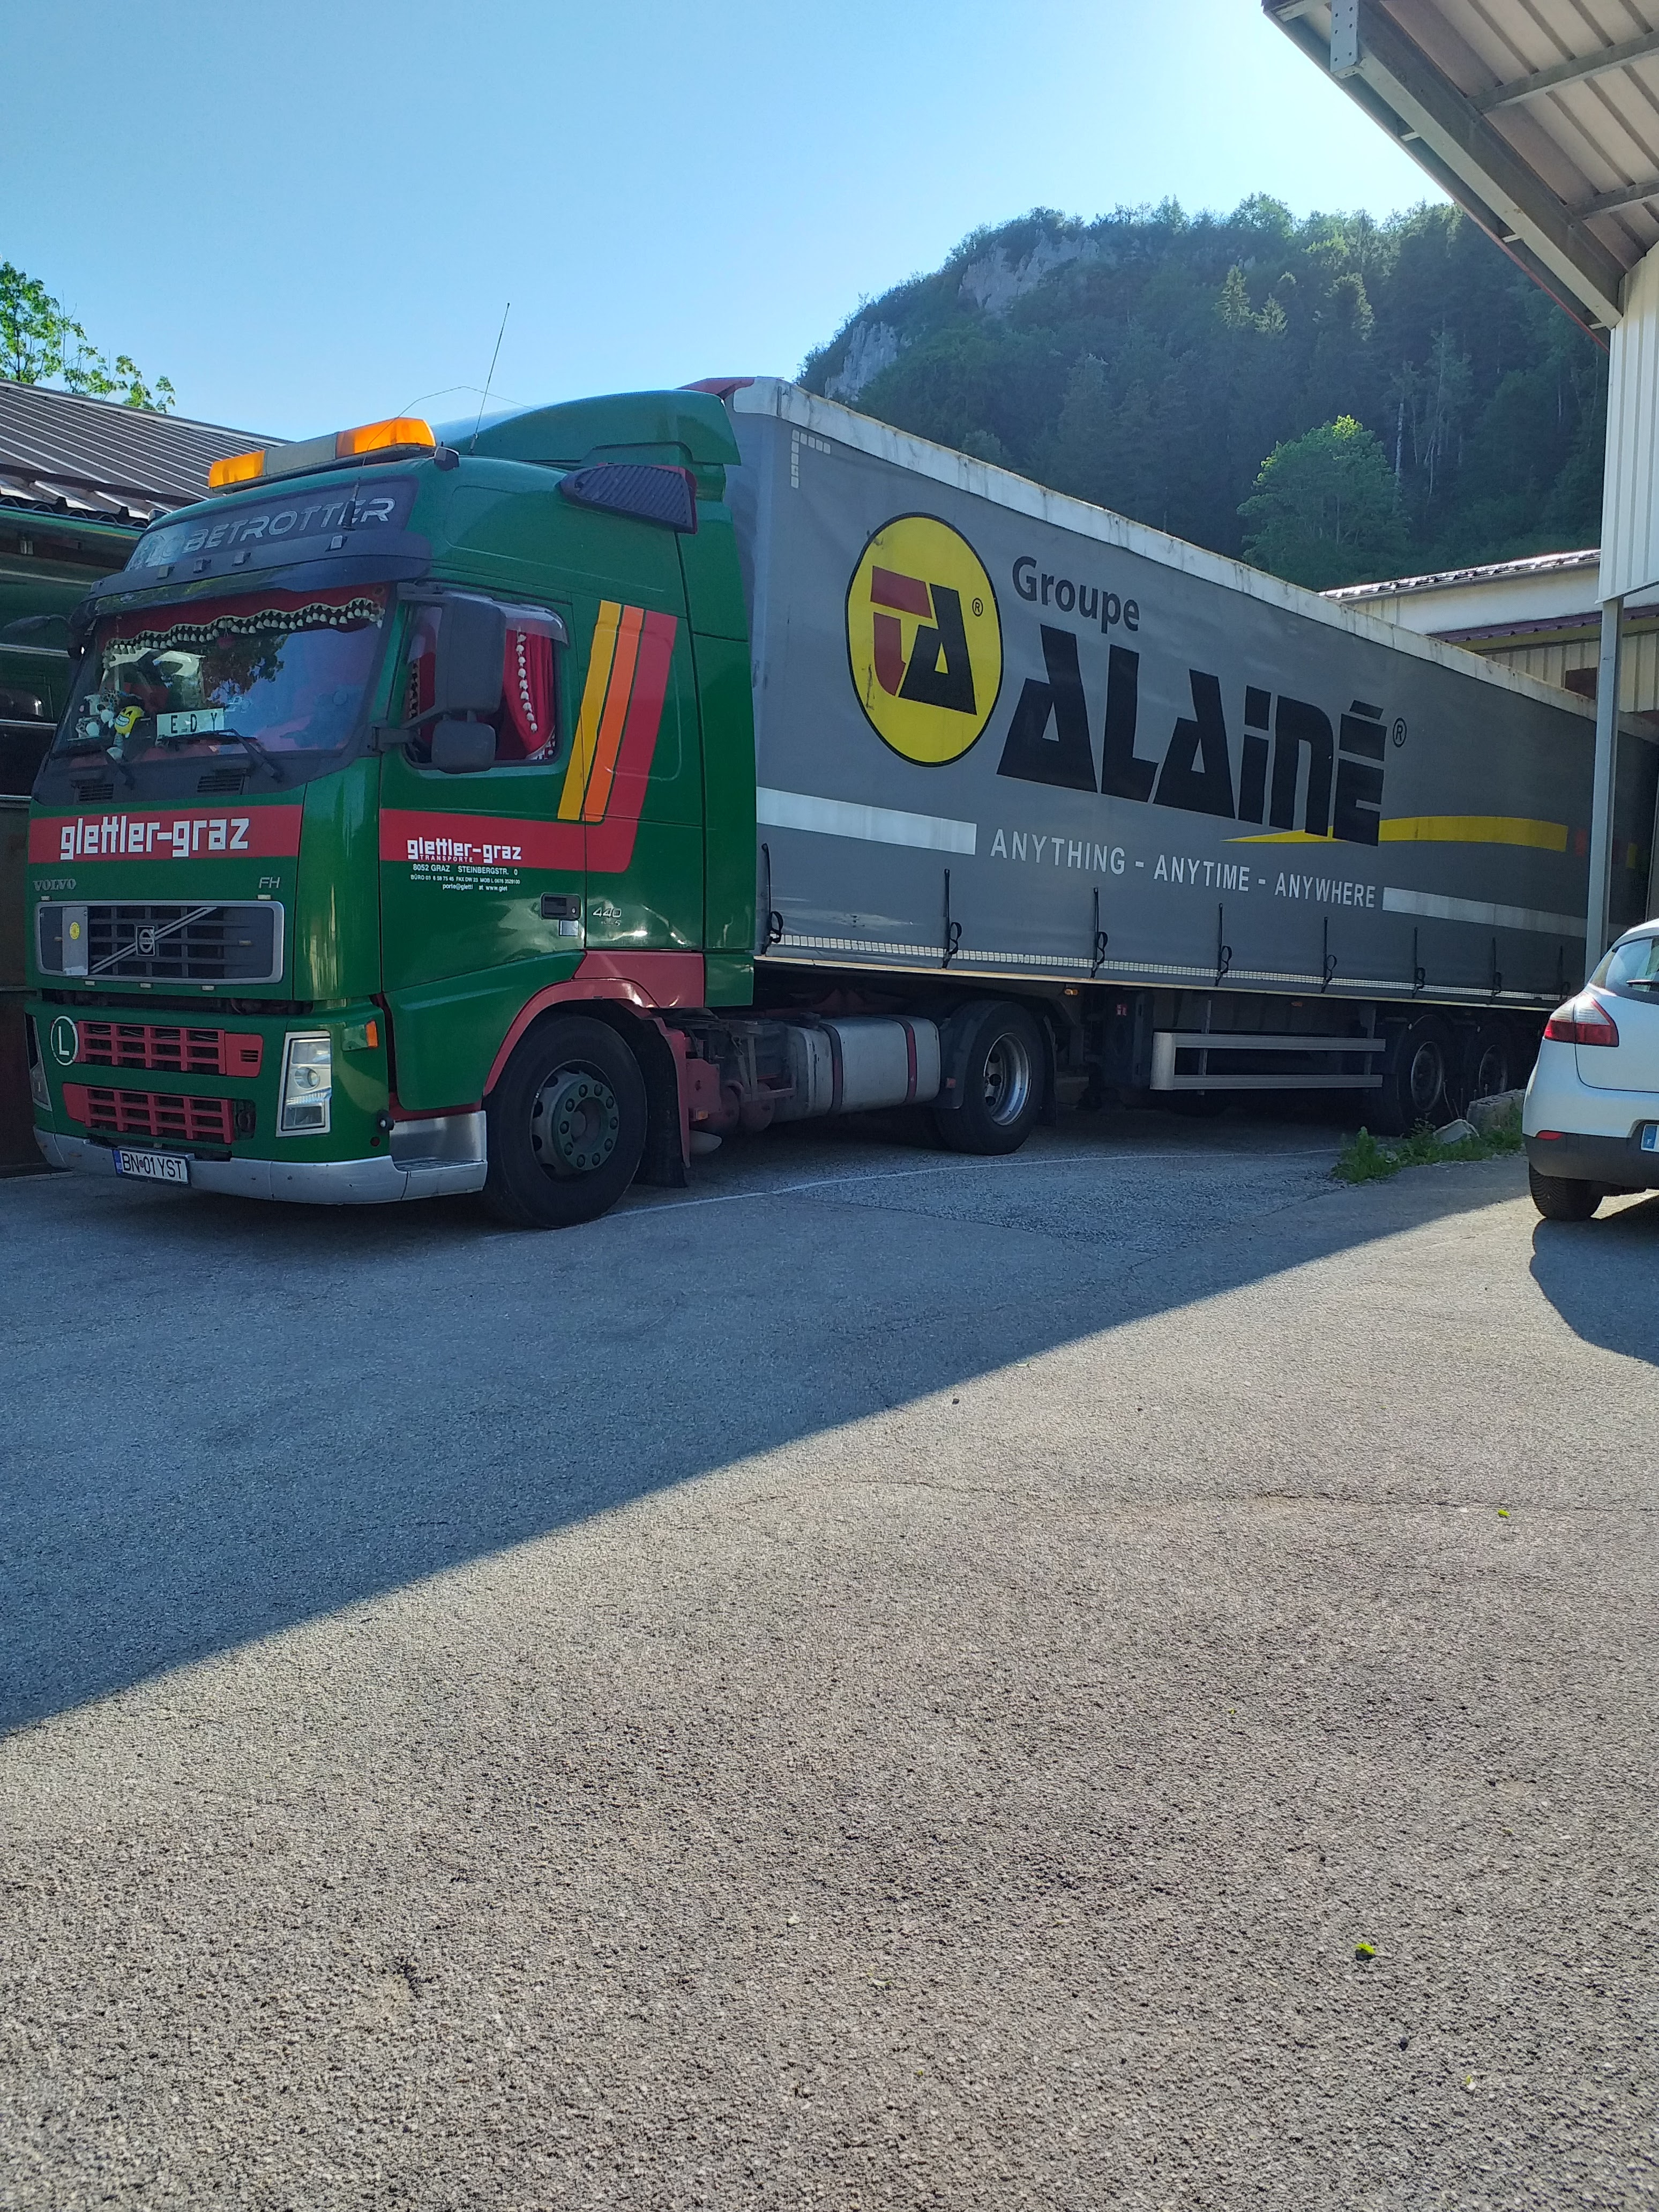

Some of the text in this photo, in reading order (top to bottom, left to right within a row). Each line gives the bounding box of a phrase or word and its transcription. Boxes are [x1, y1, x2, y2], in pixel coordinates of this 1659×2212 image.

[126, 498, 395, 568] OBETROTTER
[1012, 556, 1140, 634] Groupe
[60, 816, 250, 860] glettler-graz
[407, 836, 522, 864] glettler-graz
[413, 863, 429, 871] 8052
[430, 864, 451, 872] GRAZ
[458, 865, 509, 876] STEINBERGSTR.
[420, 854, 474, 863] TRANSPORTE
[990, 828, 1125, 875] ANYTHING
[1153, 855, 1250, 892] ANYTIME
[1274, 872, 1376, 908] ANYWHERE
[33, 878, 76, 891] VOLVO
[258, 877, 280, 889] FH
[592, 907, 622, 918] 440
[58, 1026, 70, 1056] L
[121, 1153, 182, 1179] BN 01 YST
